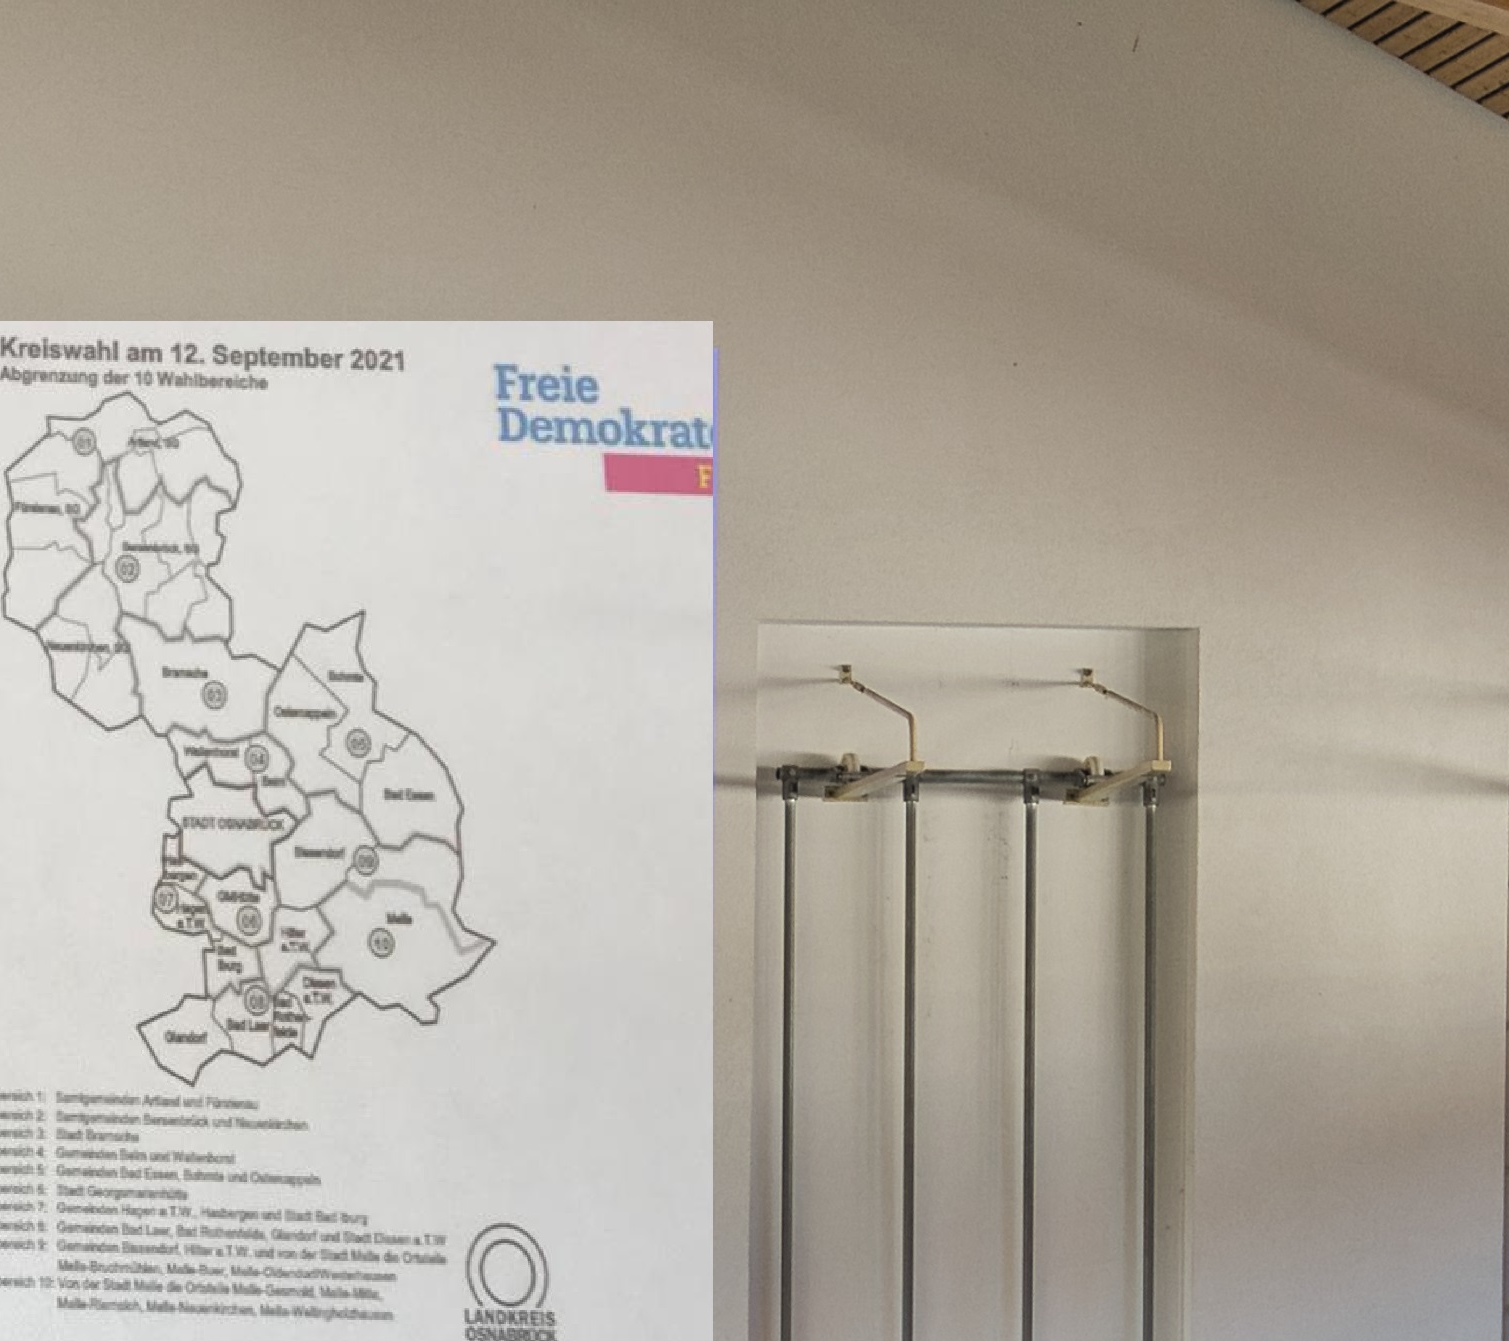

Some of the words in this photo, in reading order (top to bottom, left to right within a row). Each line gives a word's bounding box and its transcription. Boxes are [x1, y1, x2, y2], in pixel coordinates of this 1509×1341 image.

[0, 336, 119, 362] Kreiswahl
[127, 345, 163, 363] am
[170, 343, 206, 365] 12.
[212, 344, 343, 371] September
[350, 349, 406, 372] 2021
[0, 366, 98, 388] Abgrenzung
[103, 370, 130, 386] der
[134, 370, 153, 387] 10
[157, 372, 269, 391] Wahlbereiche
[492, 363, 599, 403] Freie
[464, 1308, 556, 1327] LANDKREIS
